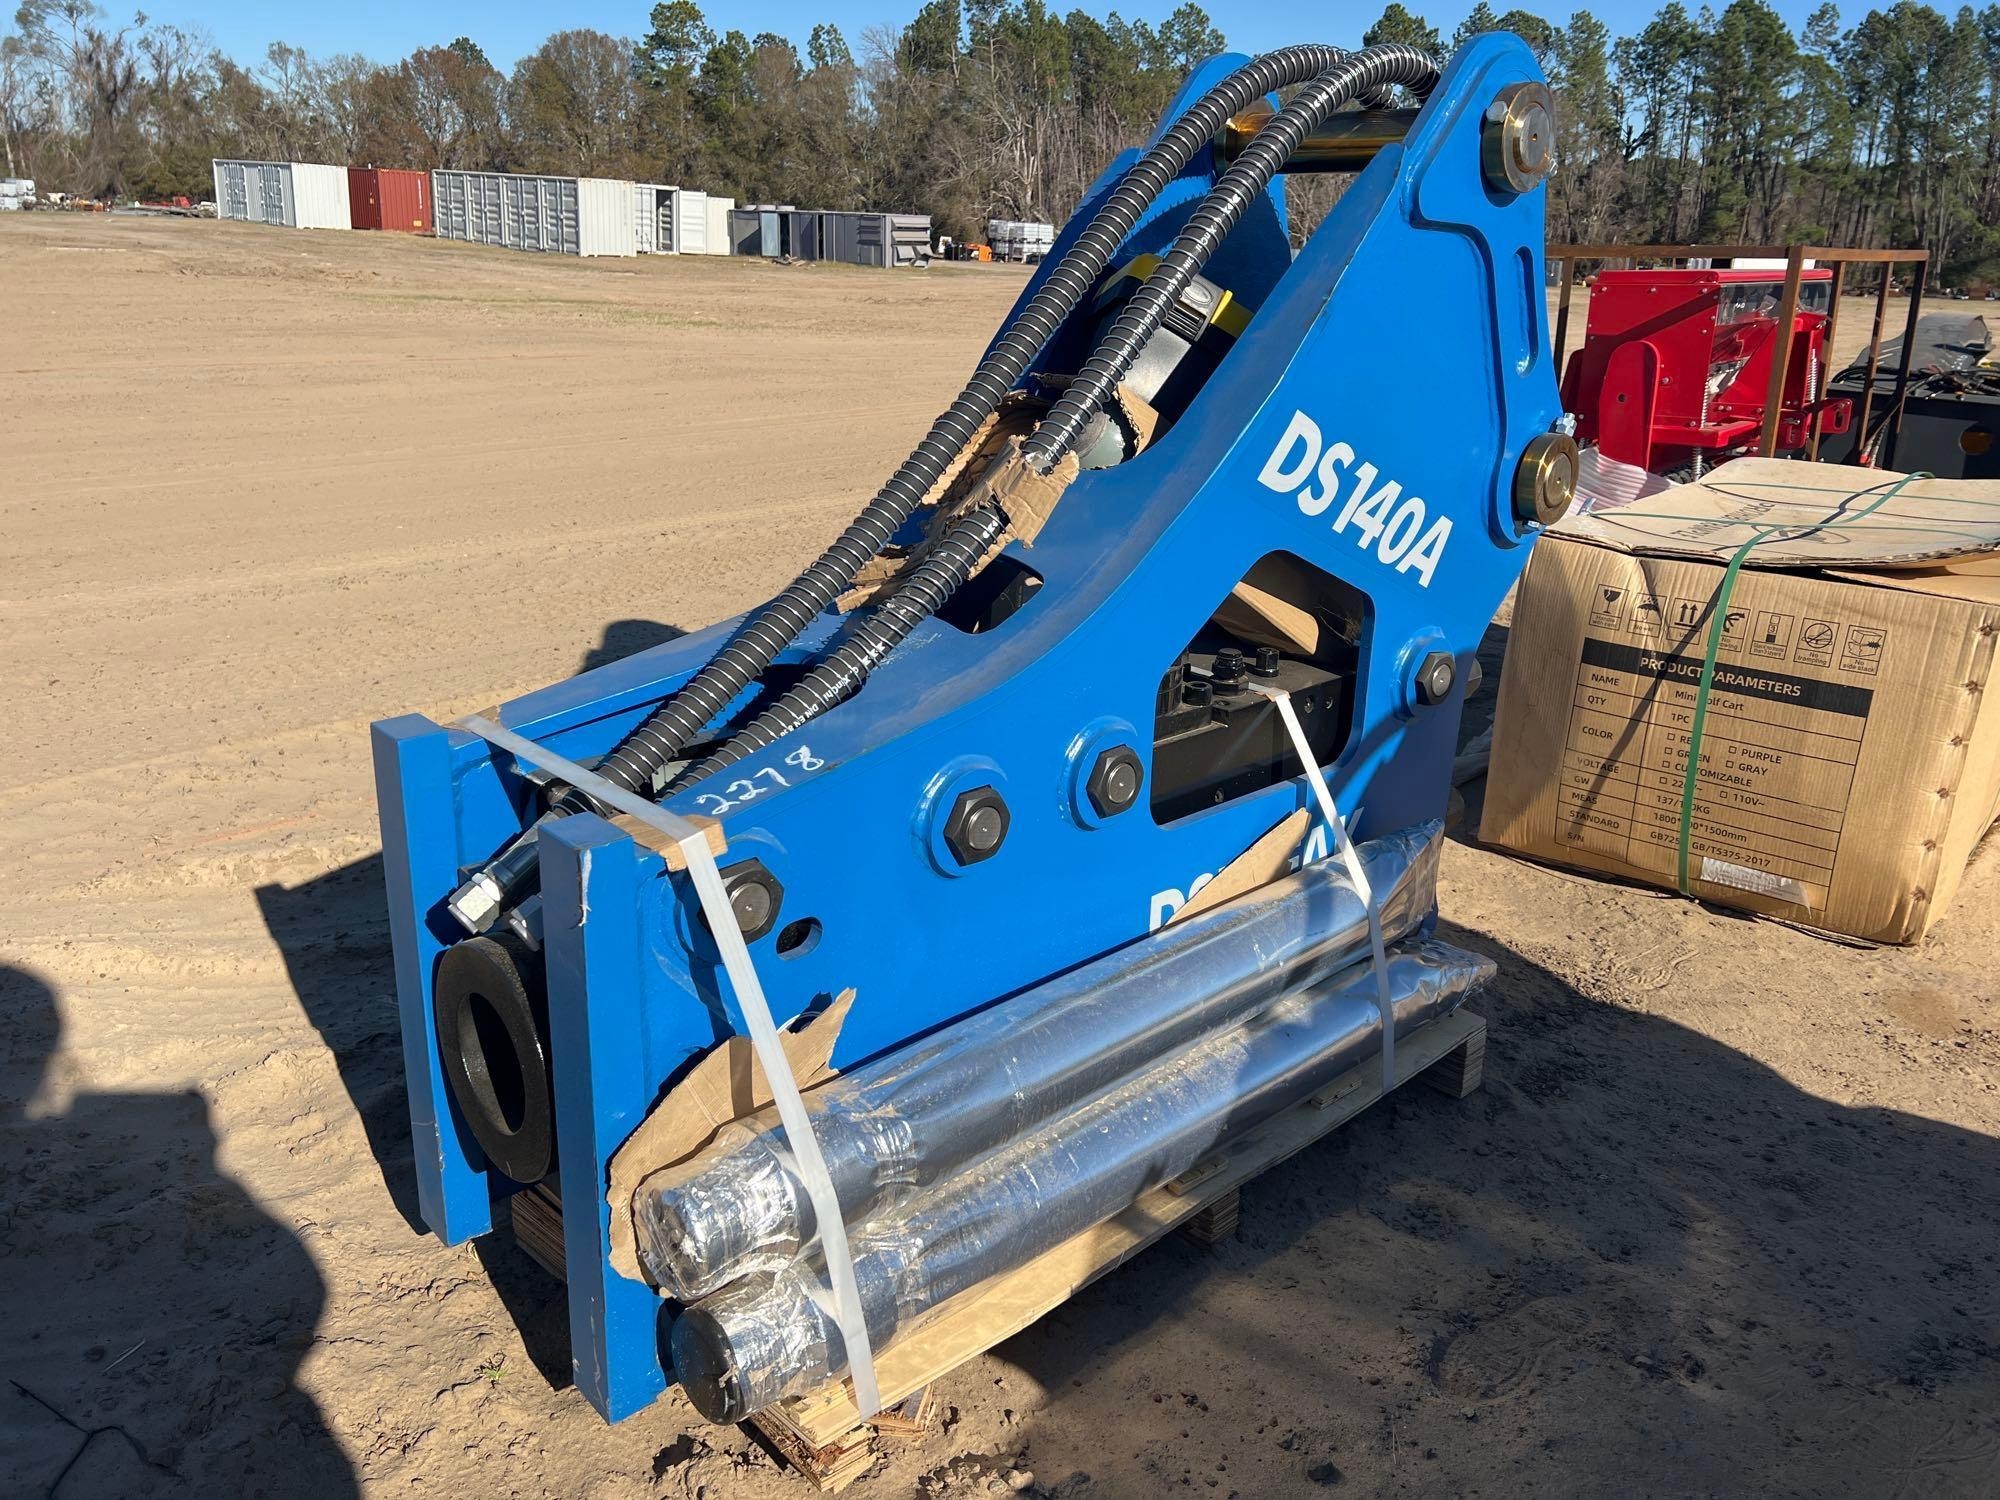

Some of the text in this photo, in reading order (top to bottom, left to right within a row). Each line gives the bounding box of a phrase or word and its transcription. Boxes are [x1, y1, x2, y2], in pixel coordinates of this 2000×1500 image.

[1257, 409, 1453, 588] DS140A
[1640, 657, 1704, 678] PRODUCT
[1797, 655, 1828, 666] trampling
[1591, 673, 1620, 686] NAME
[1587, 695, 1607, 706] QTY
[1675, 690, 1697, 702] Mini
[1722, 699, 1745, 711] Cart
[1671, 712, 1691, 724] 1PC
[1582, 726, 1614, 739] COLOR
[1680, 735, 1783, 765] RE PURPLE
[1577, 756, 1620, 774] VOLTAGE
[1677, 749, 1769, 776] GREN GRAY
[693, 744, 824, 815] 2278
[1574, 775, 1590, 785] GW
[1675, 763, 1753, 787] CUTOMIZABLE
[1571, 792, 1598, 804] MEAS
[1656, 795, 1711, 815] 137/10KG
[1569, 809, 1620, 829] STANDARD
[1567, 832, 1584, 842] S/N
[1691, 841, 1772, 867] GB/T5375-2017
